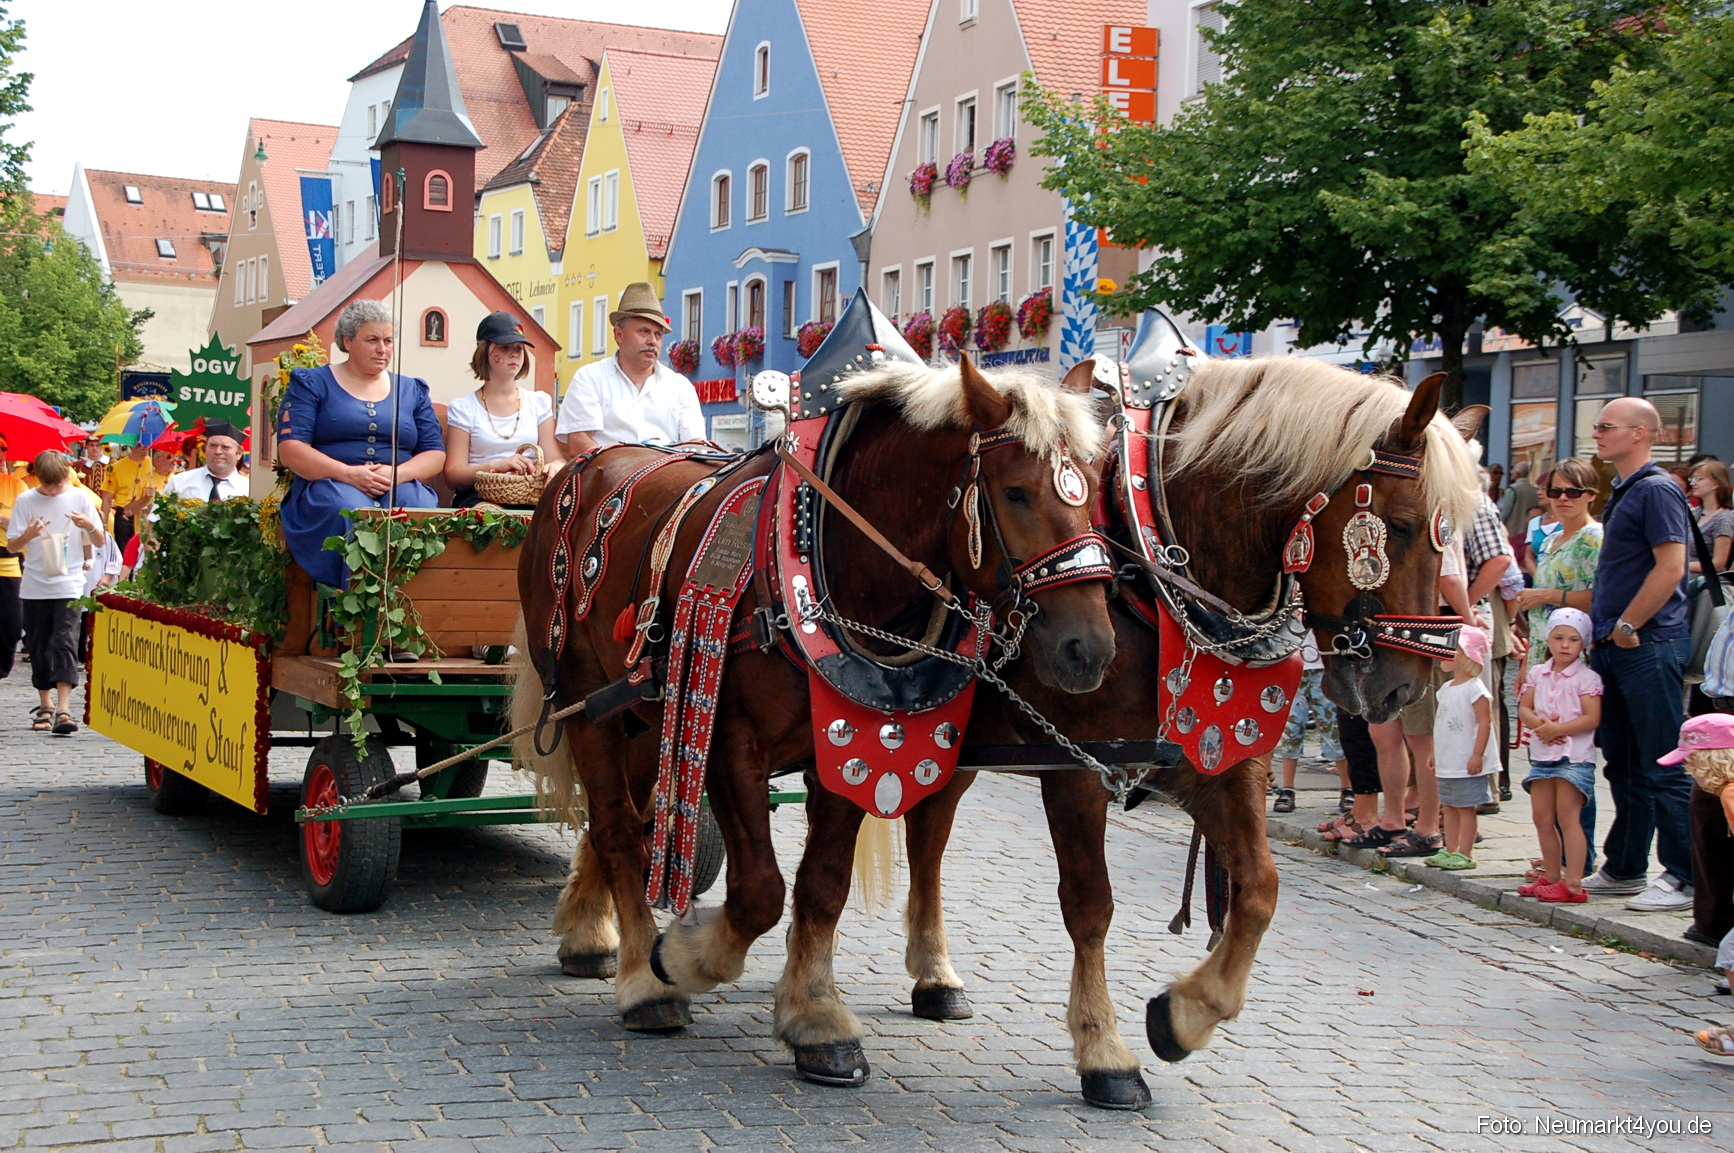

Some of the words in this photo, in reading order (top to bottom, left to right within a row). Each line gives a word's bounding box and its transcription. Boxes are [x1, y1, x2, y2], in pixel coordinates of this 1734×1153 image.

[193, 358, 237, 375] OGV
[179, 386, 246, 407] STAUF
[108, 612, 210, 706] Glockenrückführung
[217, 639, 230, 696] &
[100, 672, 197, 771] Kapellenrenovierung
[206, 707, 247, 794] Stauf
